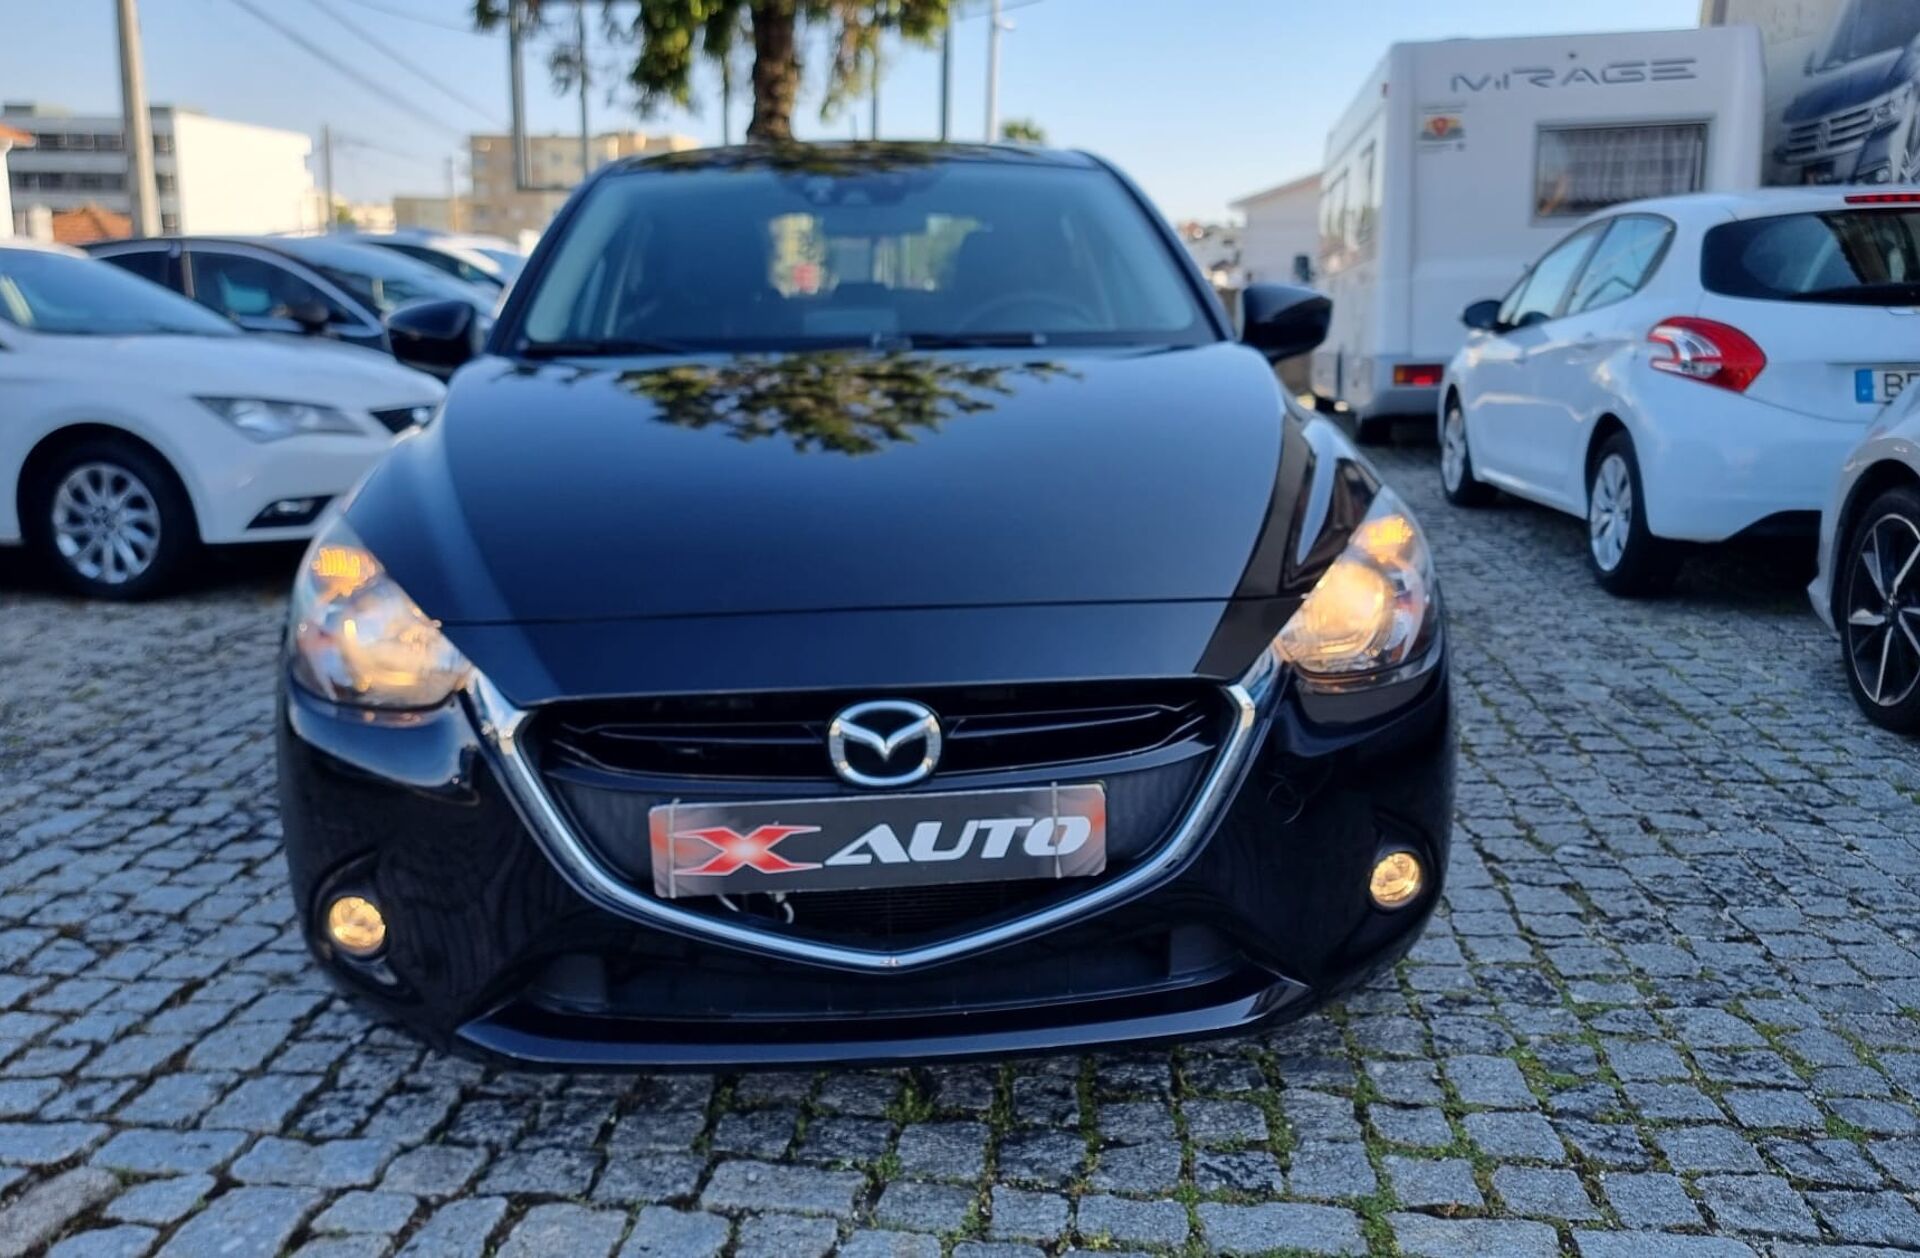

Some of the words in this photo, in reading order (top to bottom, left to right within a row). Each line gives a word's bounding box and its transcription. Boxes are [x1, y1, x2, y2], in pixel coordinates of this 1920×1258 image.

[1884, 372, 1920, 398] B
[672, 824, 823, 876] X
[823, 815, 1092, 866] AUTO
